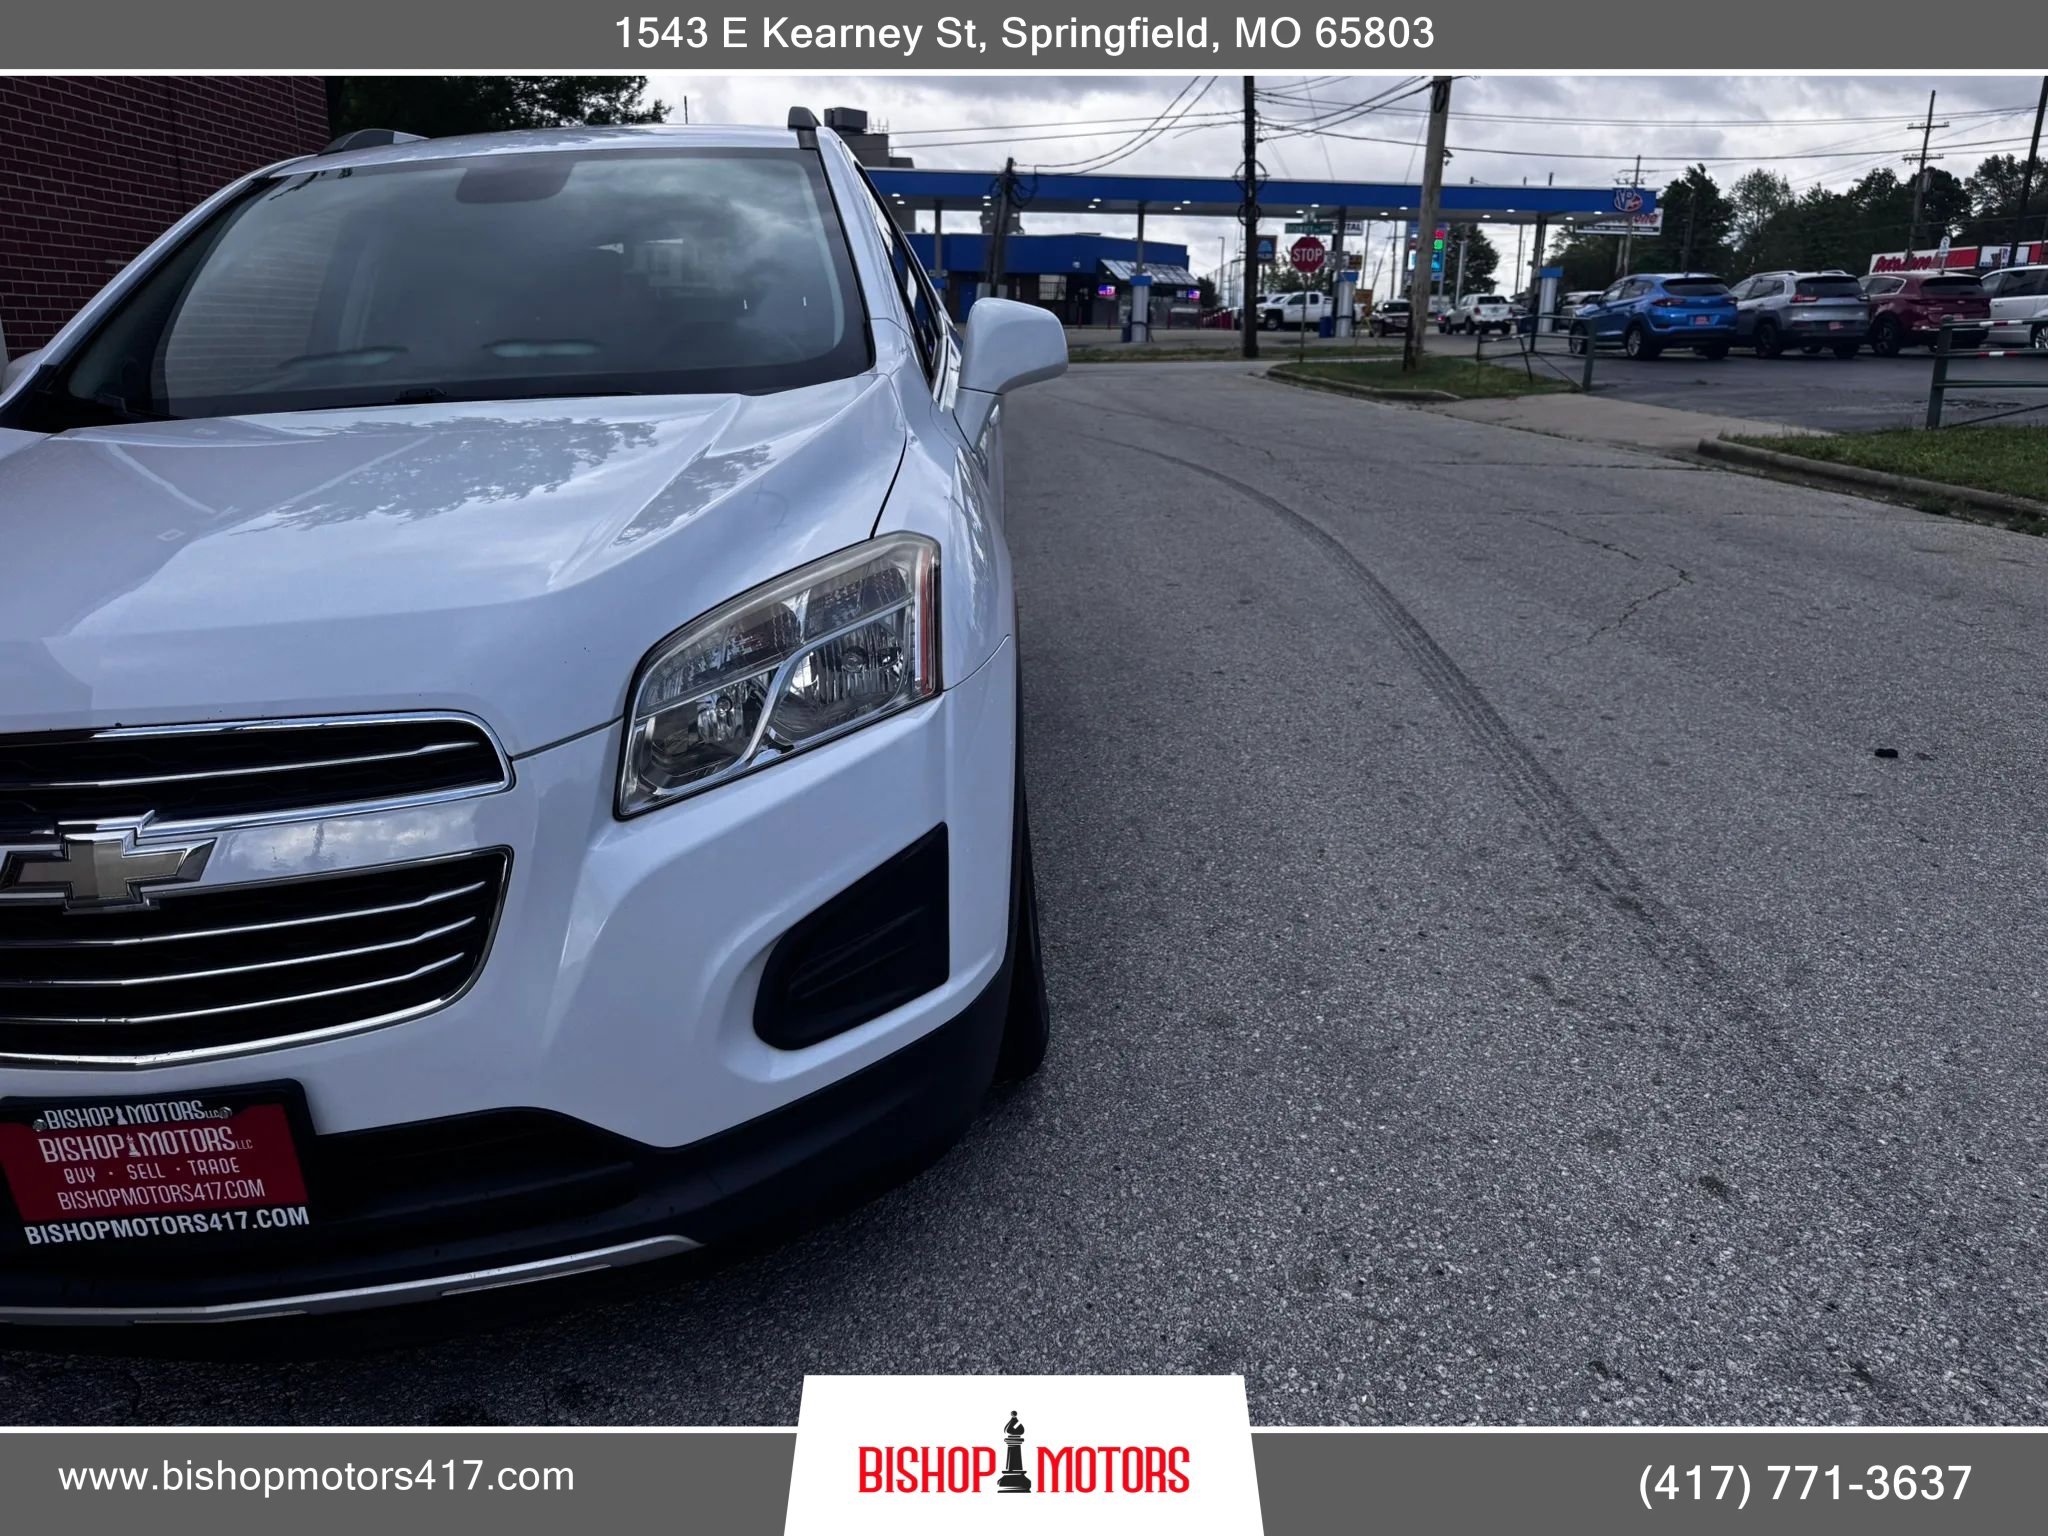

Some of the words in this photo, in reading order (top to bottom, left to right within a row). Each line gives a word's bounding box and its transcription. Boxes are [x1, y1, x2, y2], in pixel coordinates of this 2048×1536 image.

[1292, 248, 1323, 262] STOP
[43, 1106, 114, 1130] BISHOP
[127, 1100, 205, 1124] MOTORS
[38, 1131, 126, 1163] BISHOP
[137, 1126, 236, 1156] MOTORS
[236, 1138, 253, 1150] LLC
[64, 1167, 96, 1184] BUY
[127, 1163, 165, 1180] SELL
[187, 1157, 241, 1176] TRADE
[57, 1178, 265, 1210] BISHOPMOTORS417.COM
[24, 1206, 310, 1245] BISHOPMOTORS417.COM
